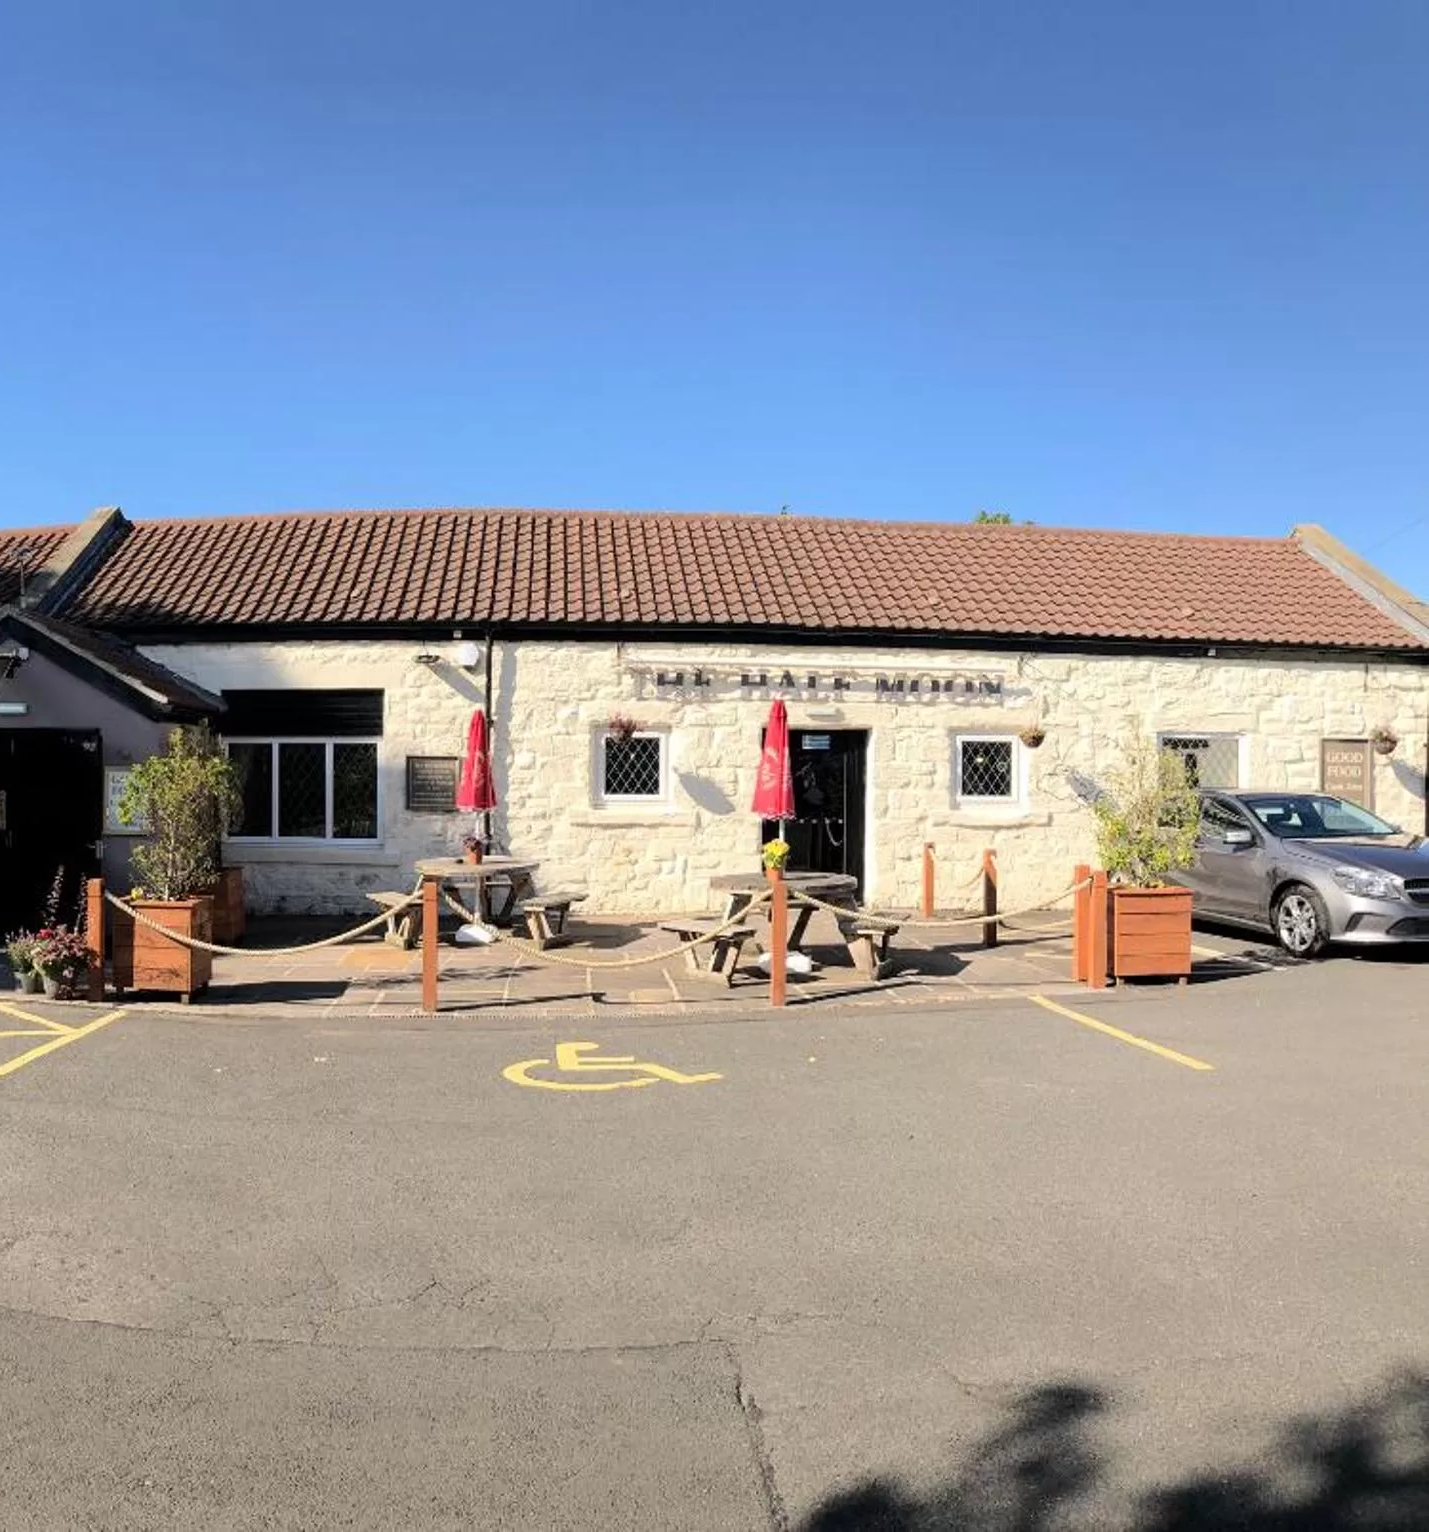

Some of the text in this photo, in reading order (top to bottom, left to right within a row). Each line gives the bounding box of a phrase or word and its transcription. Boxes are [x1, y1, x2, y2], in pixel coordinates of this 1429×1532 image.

[739, 668, 852, 701] HALF
[874, 672, 1004, 706] MOON
[1326, 752, 1363, 763] GOOD
[1327, 766, 1362, 778] FOOD
